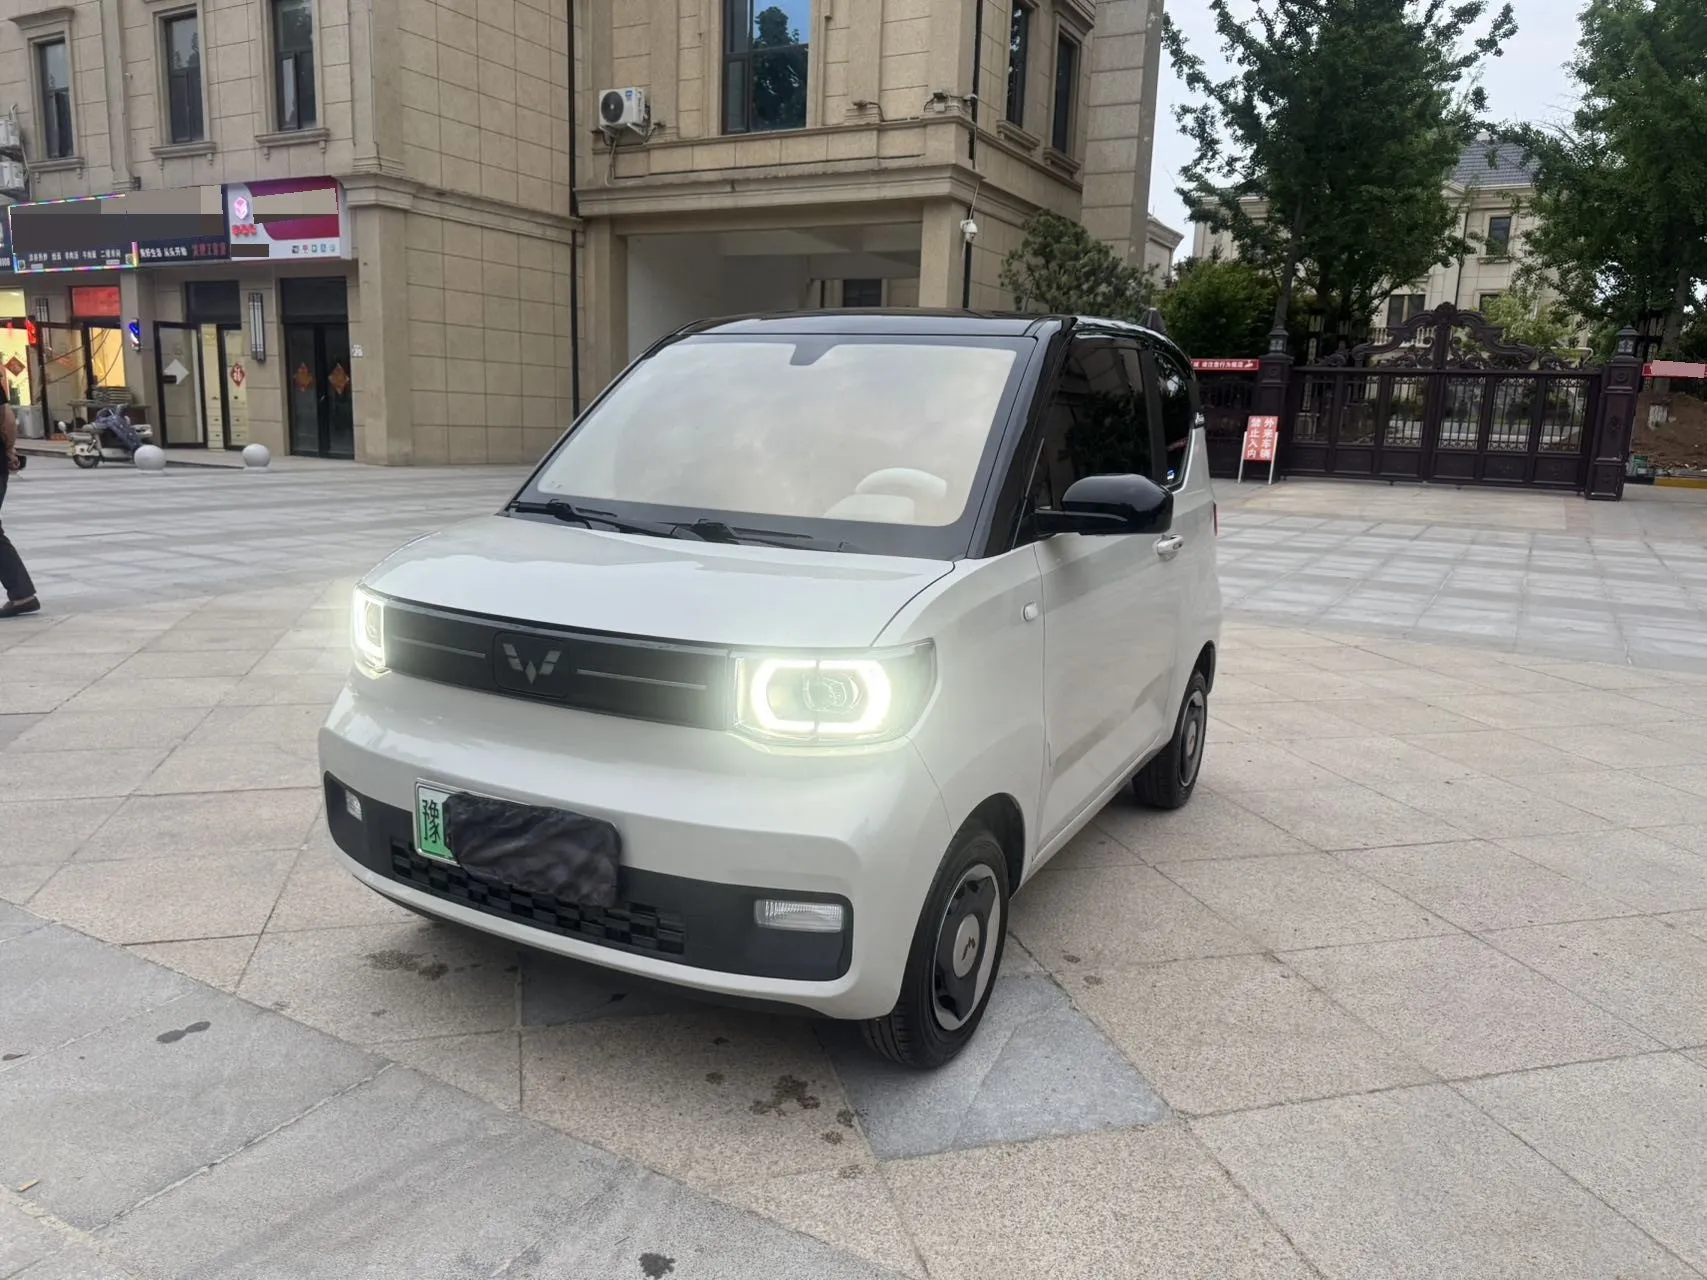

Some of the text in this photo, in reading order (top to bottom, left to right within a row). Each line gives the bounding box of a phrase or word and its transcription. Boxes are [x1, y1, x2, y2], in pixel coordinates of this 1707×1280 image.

[1247, 418, 1261, 459] 禁止入内
[1260, 418, 1274, 459] 外来车辆
[421, 799, 441, 844] 豫
